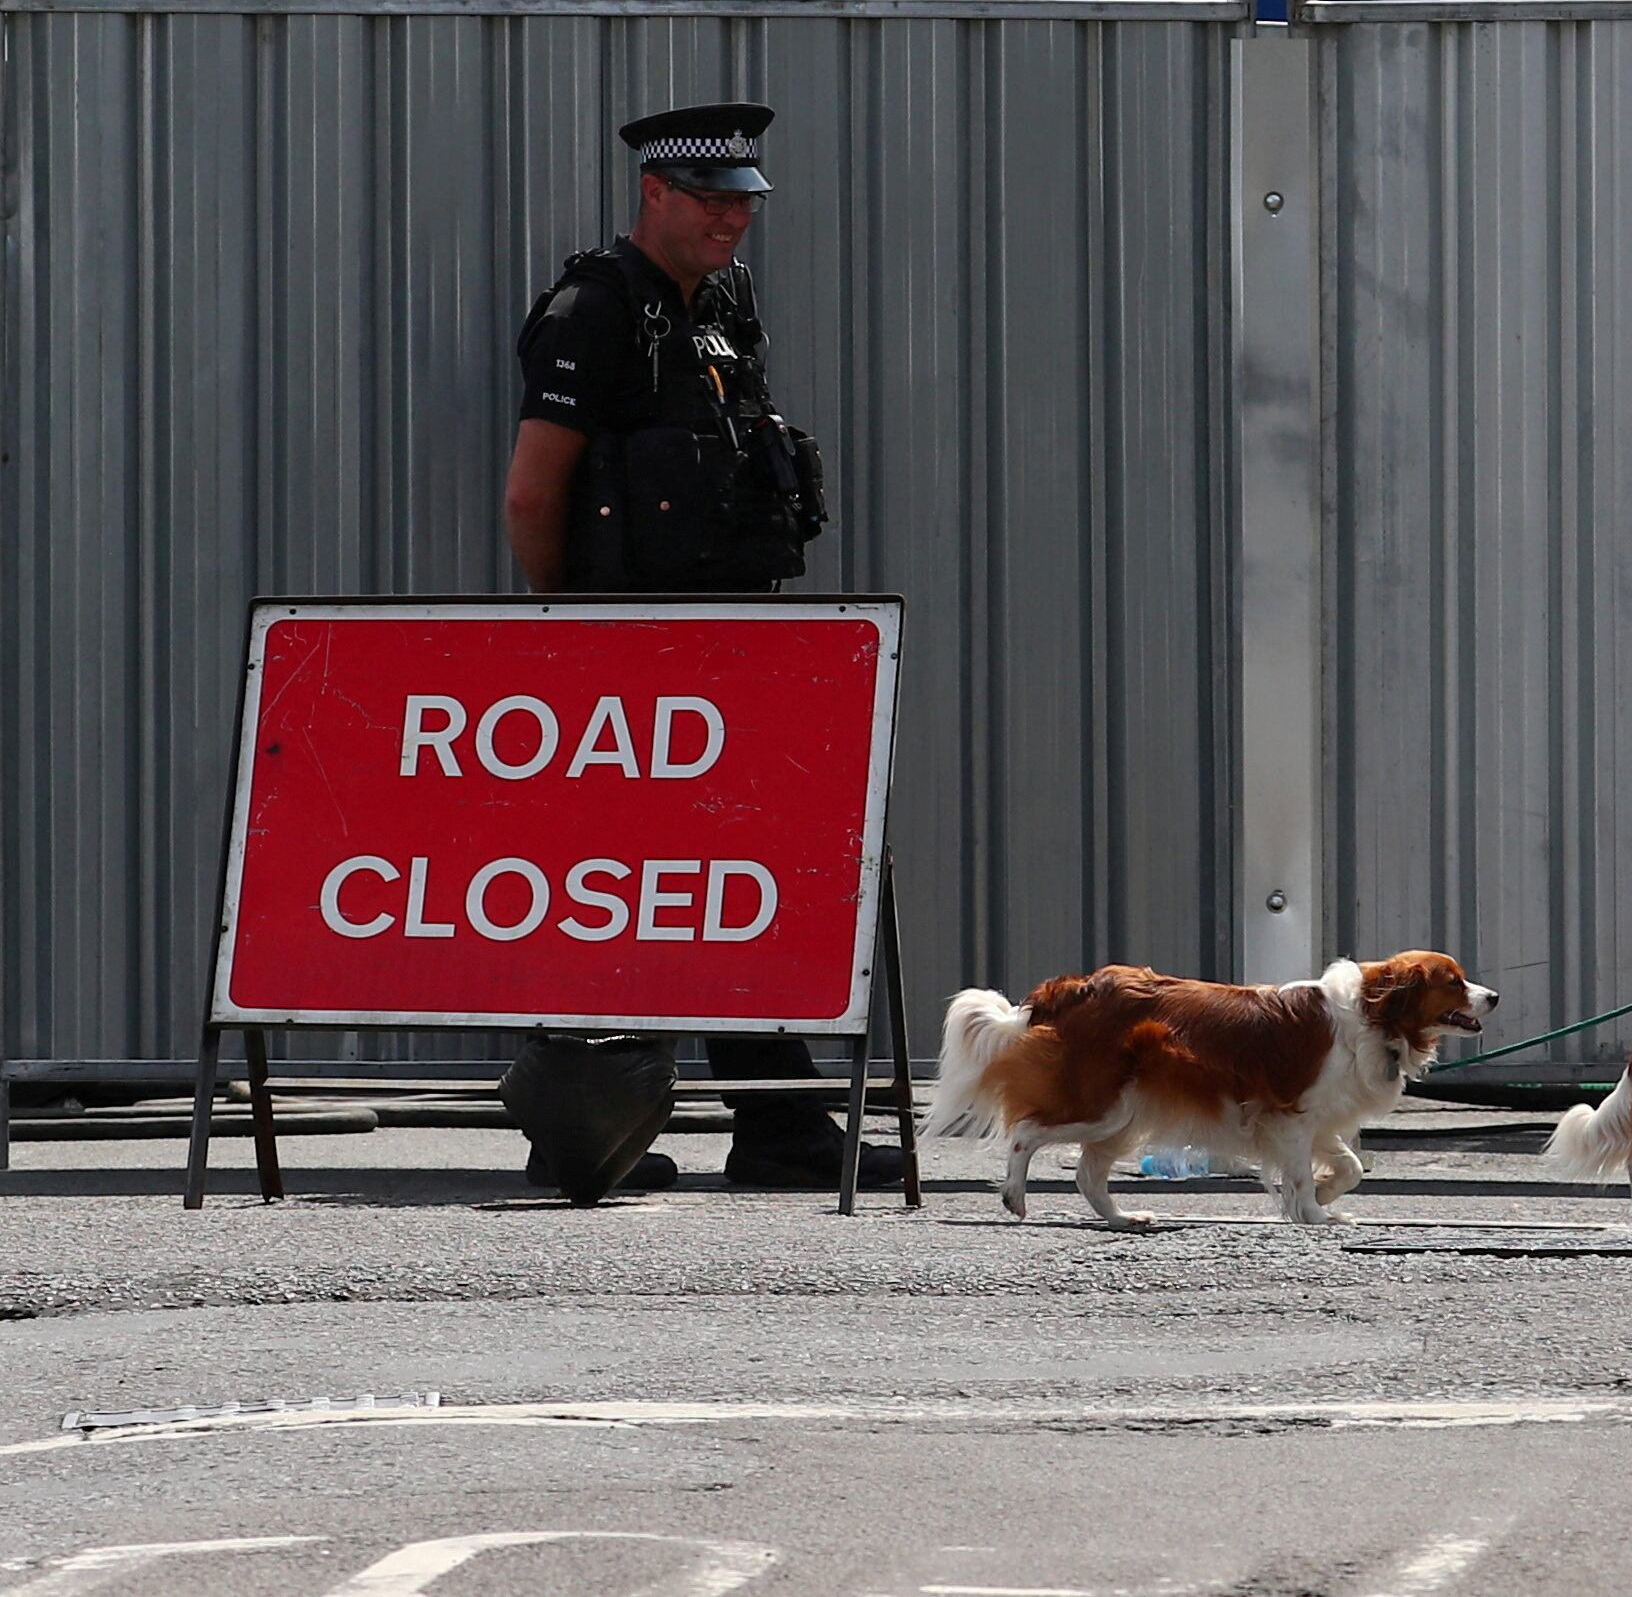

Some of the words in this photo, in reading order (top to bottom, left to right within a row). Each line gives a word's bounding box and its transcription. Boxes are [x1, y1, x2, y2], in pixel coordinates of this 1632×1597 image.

[542, 392, 576, 406] POLICE
[399, 695, 725, 780] ROAD
[320, 855, 778, 942] CLOSED
